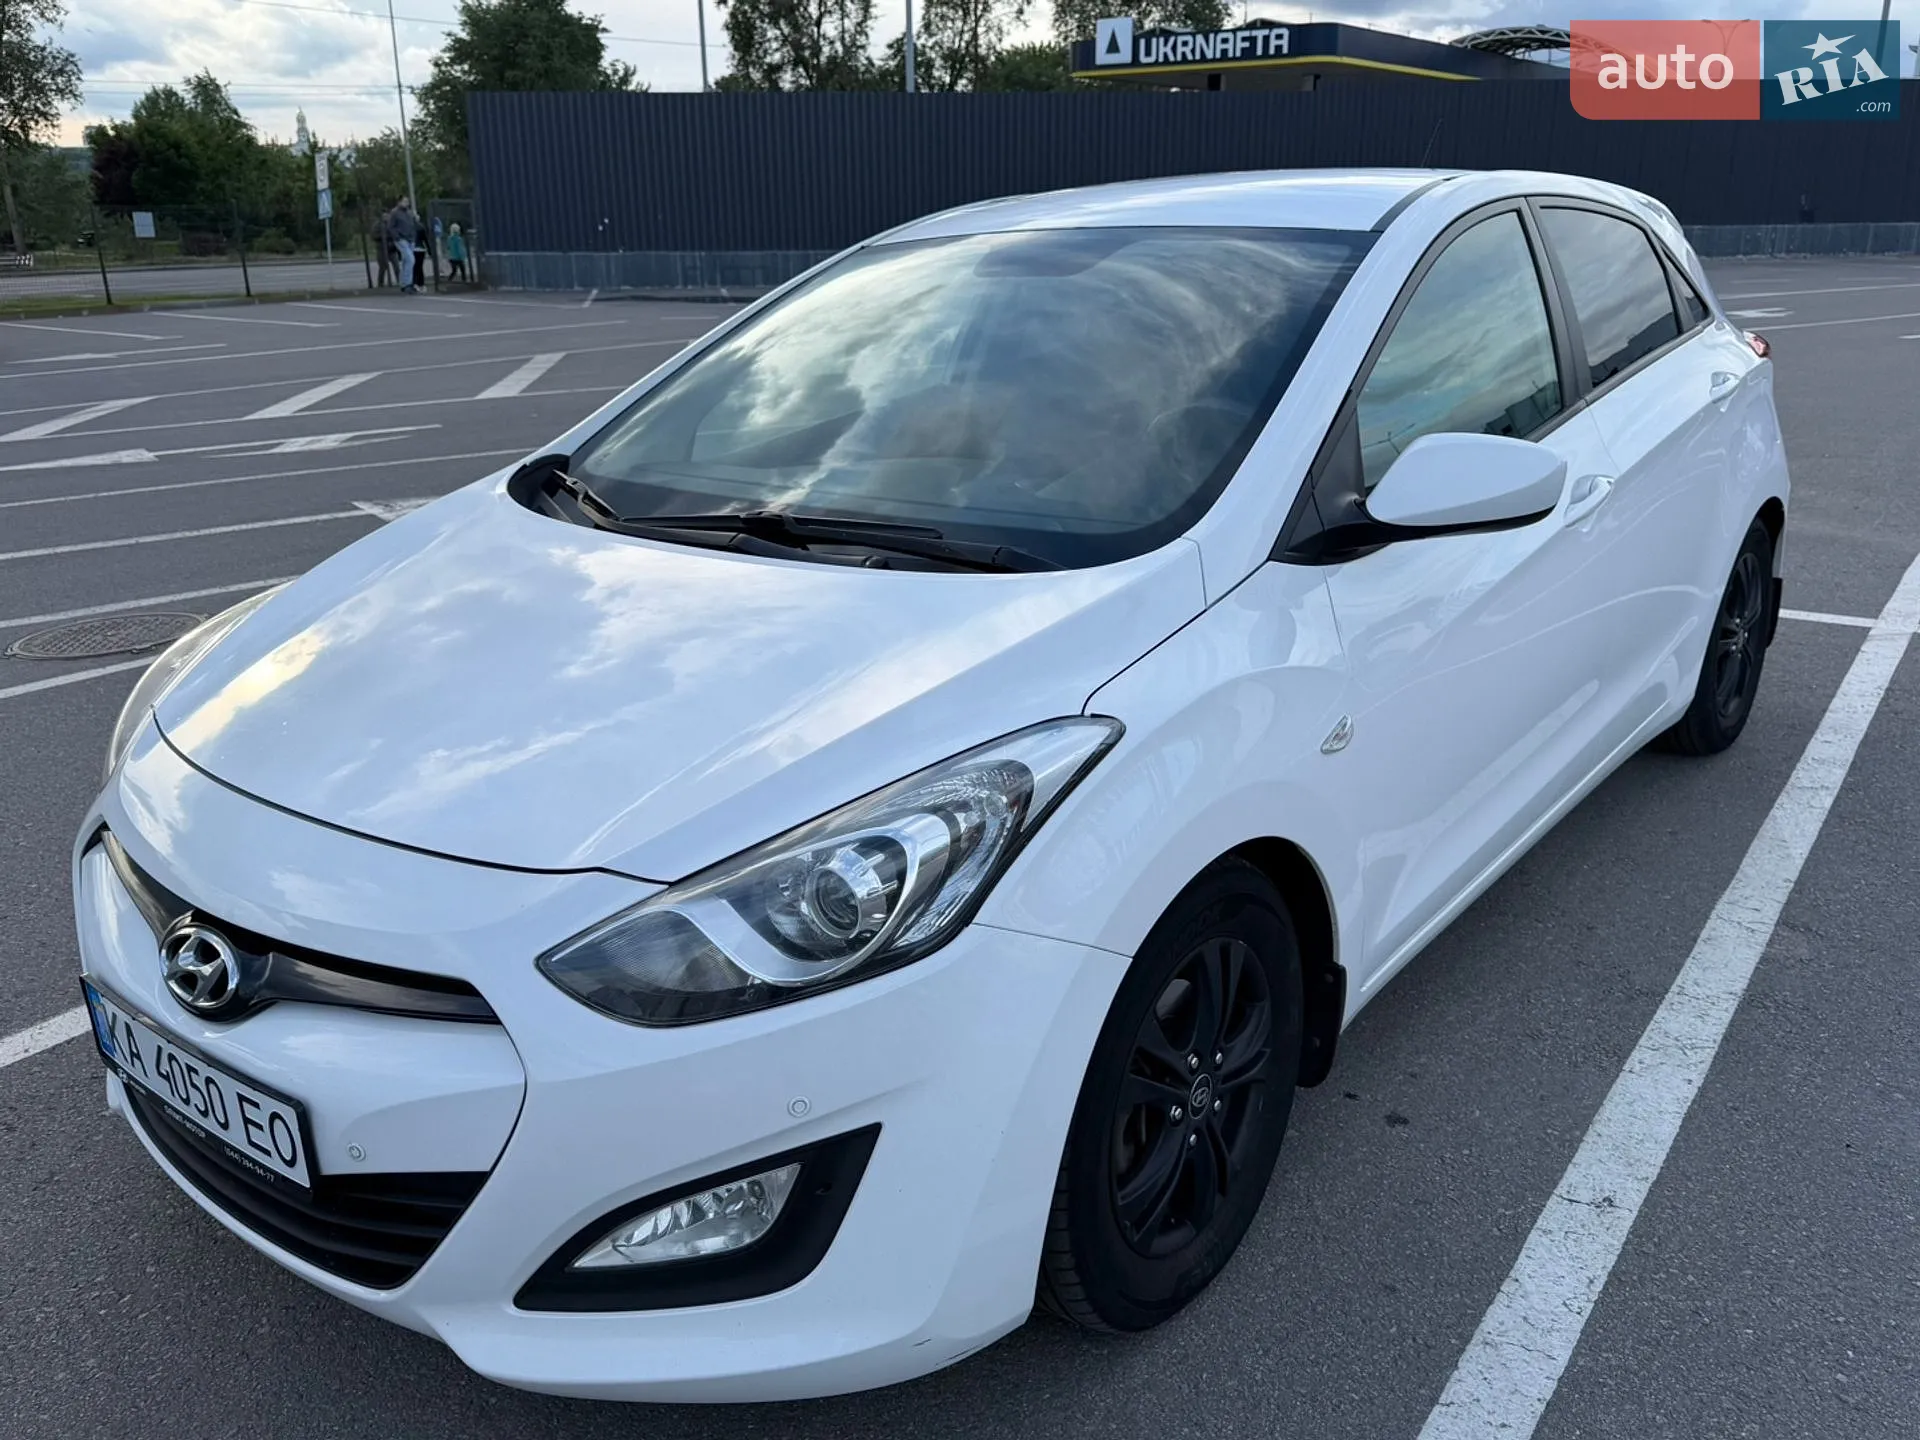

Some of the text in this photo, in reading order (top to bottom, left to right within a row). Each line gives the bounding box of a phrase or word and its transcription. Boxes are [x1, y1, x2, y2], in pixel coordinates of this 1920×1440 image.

[1138, 27, 1290, 64] UKRNAFTA
[110, 1012, 149, 1078] KA
[155, 1044, 230, 1132] 4050
[236, 1091, 298, 1168] EO
